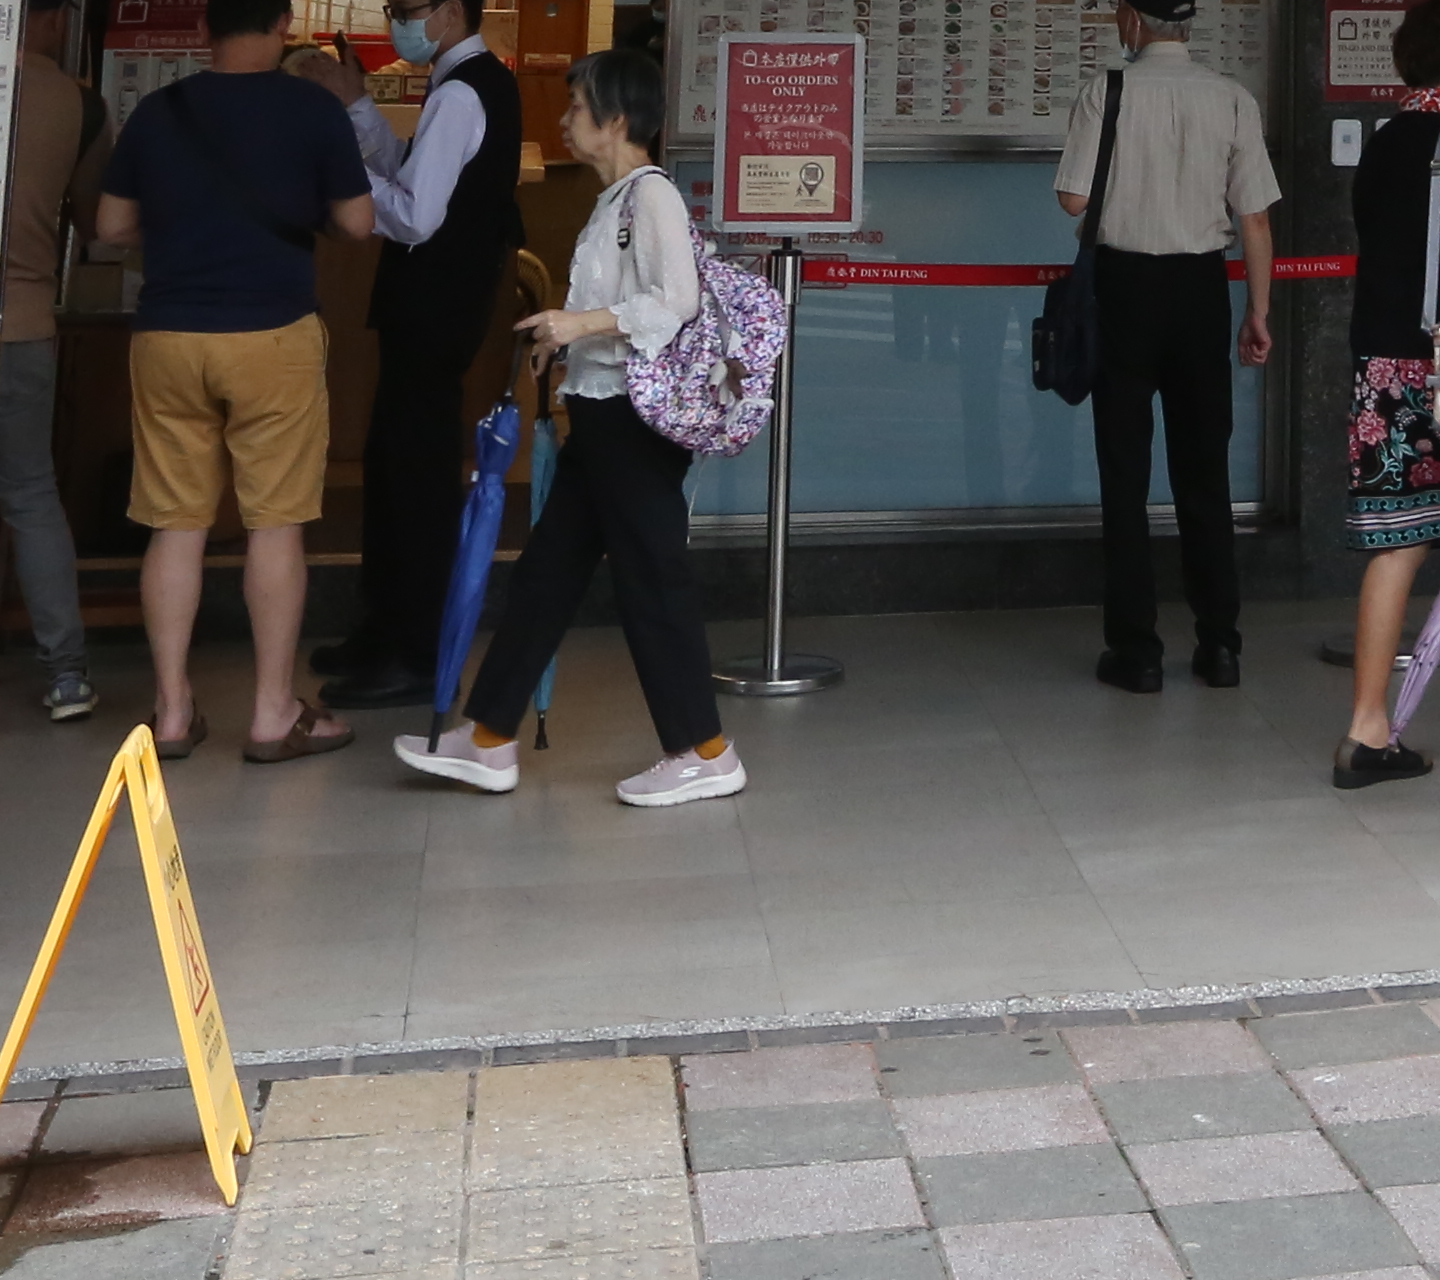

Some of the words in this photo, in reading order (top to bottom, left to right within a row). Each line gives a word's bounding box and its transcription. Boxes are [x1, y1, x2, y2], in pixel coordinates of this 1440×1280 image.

[760, 51, 839, 68] 本店僅供外帶
[744, 75, 785, 85] TO-GO
[788, 75, 838, 85] ORDERS
[772, 87, 806, 97] ONLY
[1276, 263, 1294, 272] DIN
[1296, 263, 1312, 271] TAI
[1314, 262, 1340, 271] FUNG
[860, 268, 879, 278] DIN
[881, 268, 898, 278] TAI
[900, 269, 927, 279] FUNG
